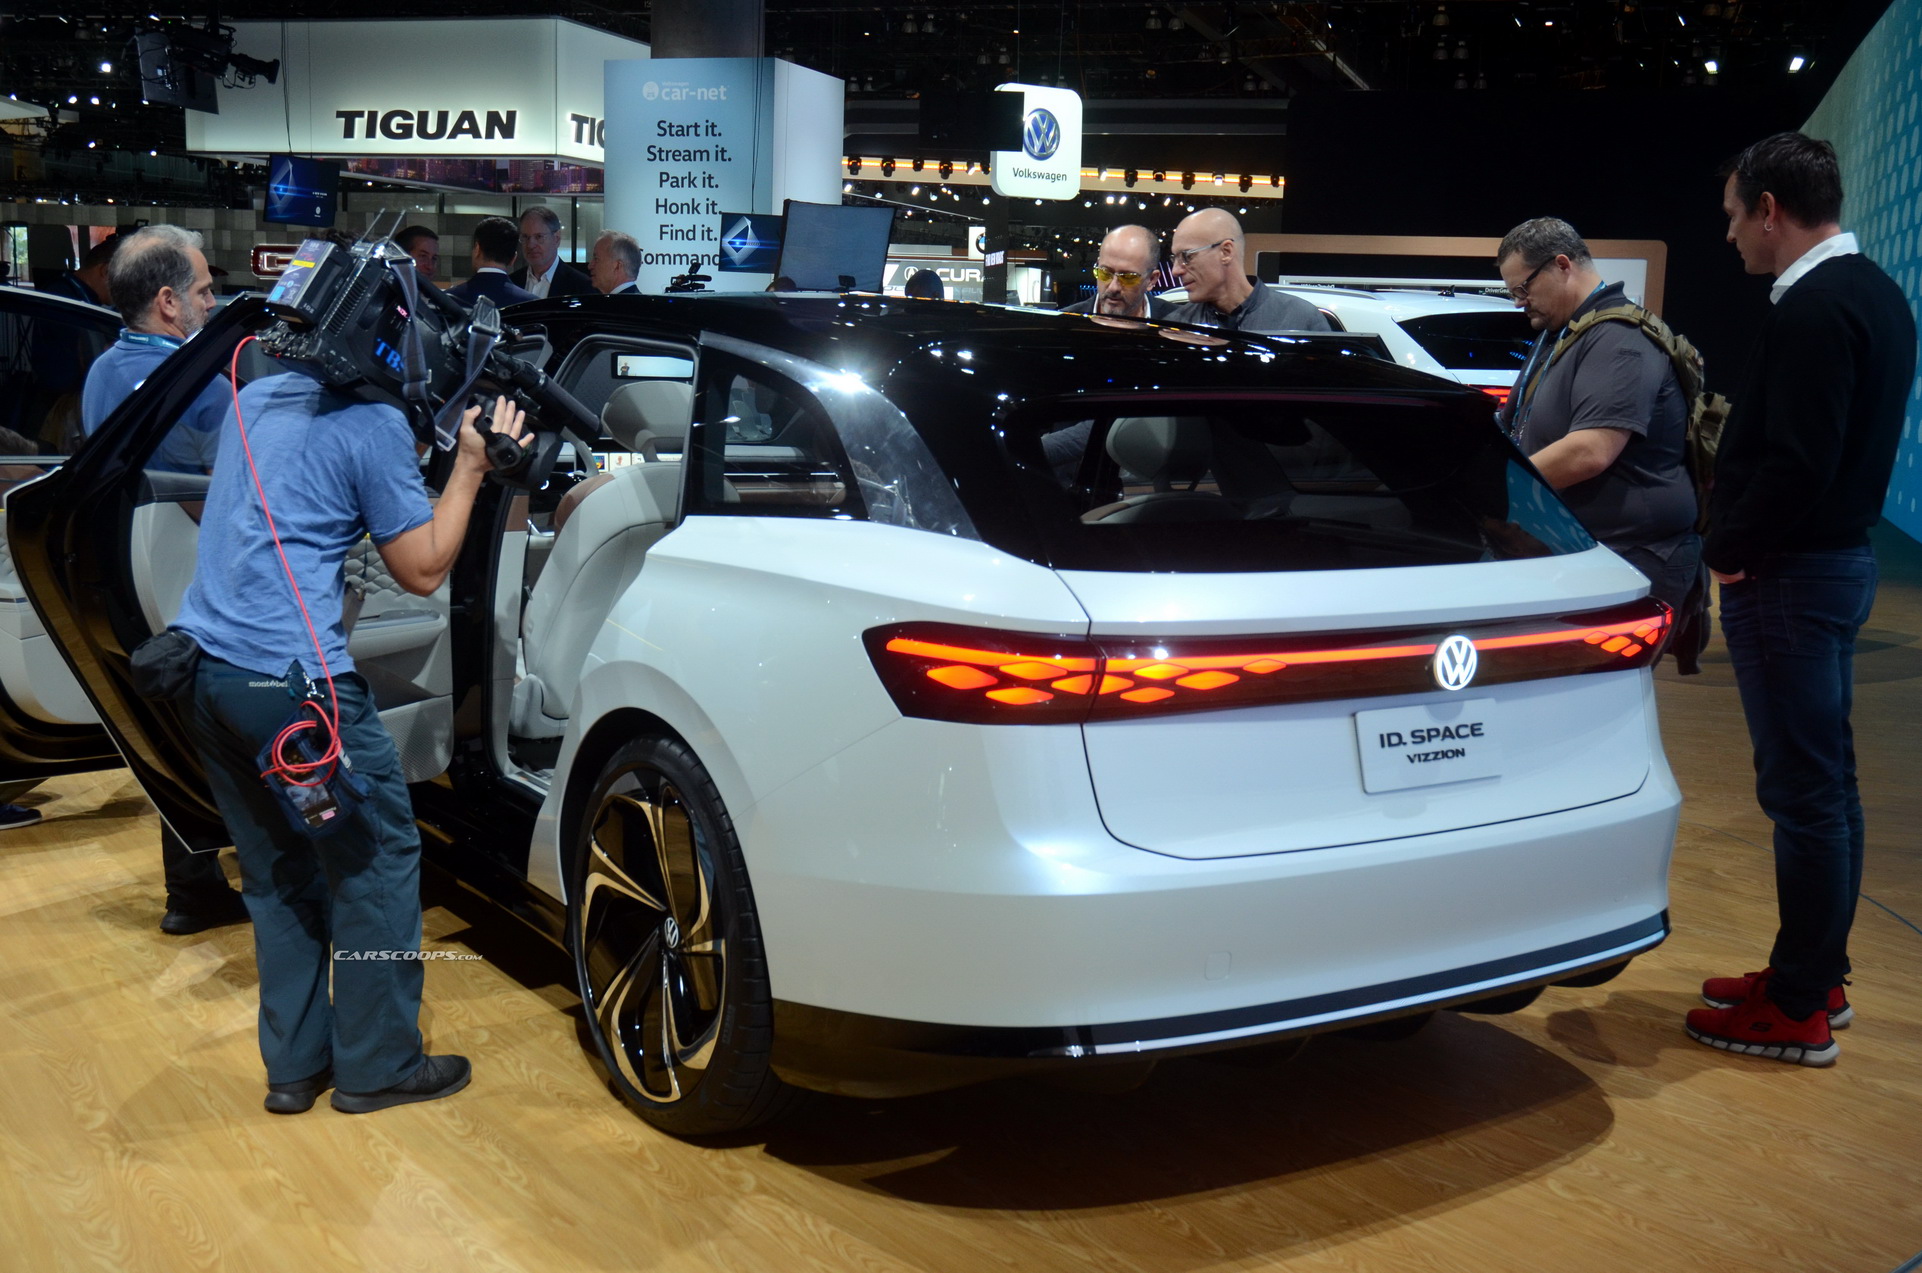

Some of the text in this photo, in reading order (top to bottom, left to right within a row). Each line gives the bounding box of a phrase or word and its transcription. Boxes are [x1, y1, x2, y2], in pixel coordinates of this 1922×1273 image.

[661, 85, 727, 100] car-net
[336, 110, 517, 140] TIGUAN
[657, 119, 722, 137] Start it.
[647, 144, 732, 162] Stream it.
[659, 171, 719, 188] Park it.
[1012, 167, 1067, 183] Volkswagen
[656, 197, 722, 215] Honk it.
[660, 224, 718, 241] Find it.
[926, 268, 984, 282] CUR
[1379, 722, 1484, 748] ID. SPACE
[1406, 747, 1466, 764] VIZZION
